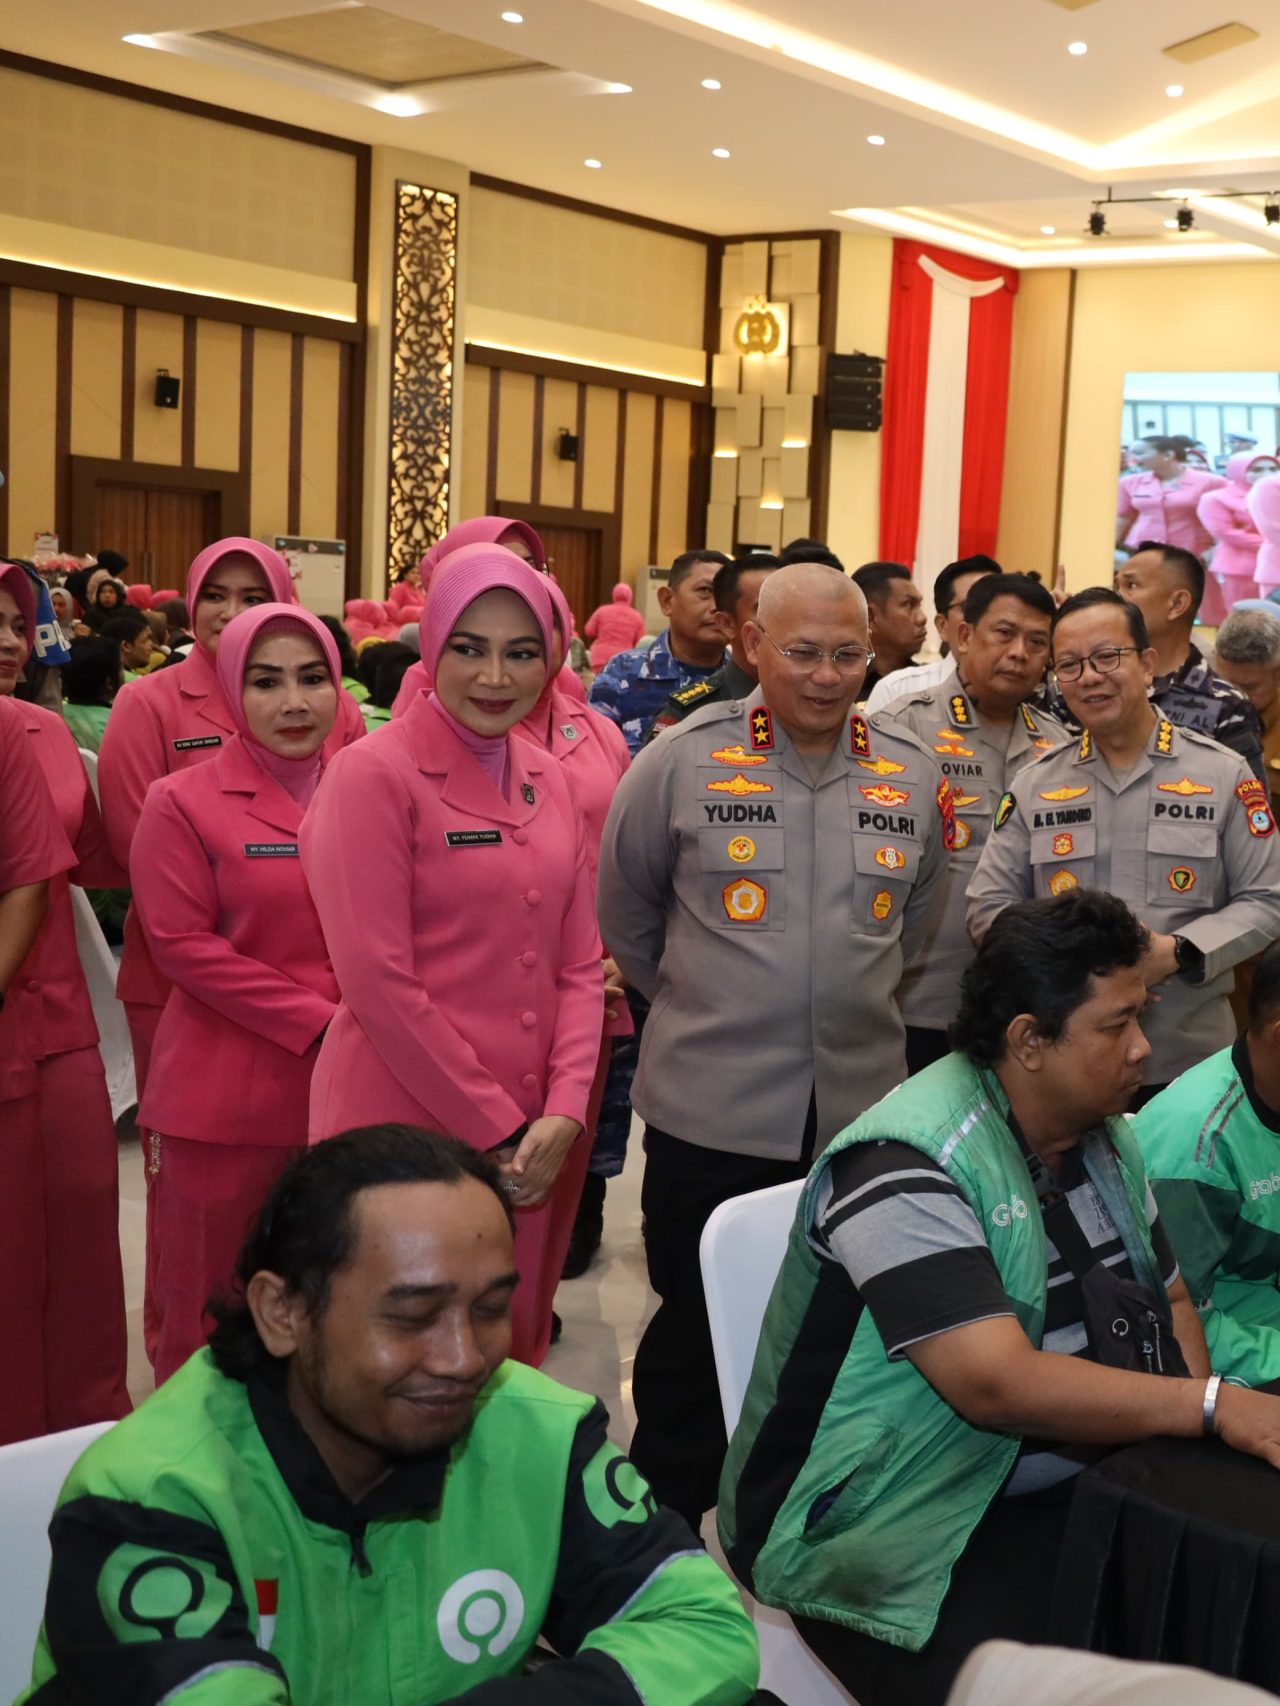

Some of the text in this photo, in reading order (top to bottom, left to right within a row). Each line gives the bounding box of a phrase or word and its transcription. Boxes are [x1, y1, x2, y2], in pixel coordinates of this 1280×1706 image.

[941, 762, 984, 777] OVIAR
[704, 804, 777, 823] YUDHA
[1154, 803, 1215, 820] POLRI
[858, 811, 915, 835] POLRI
